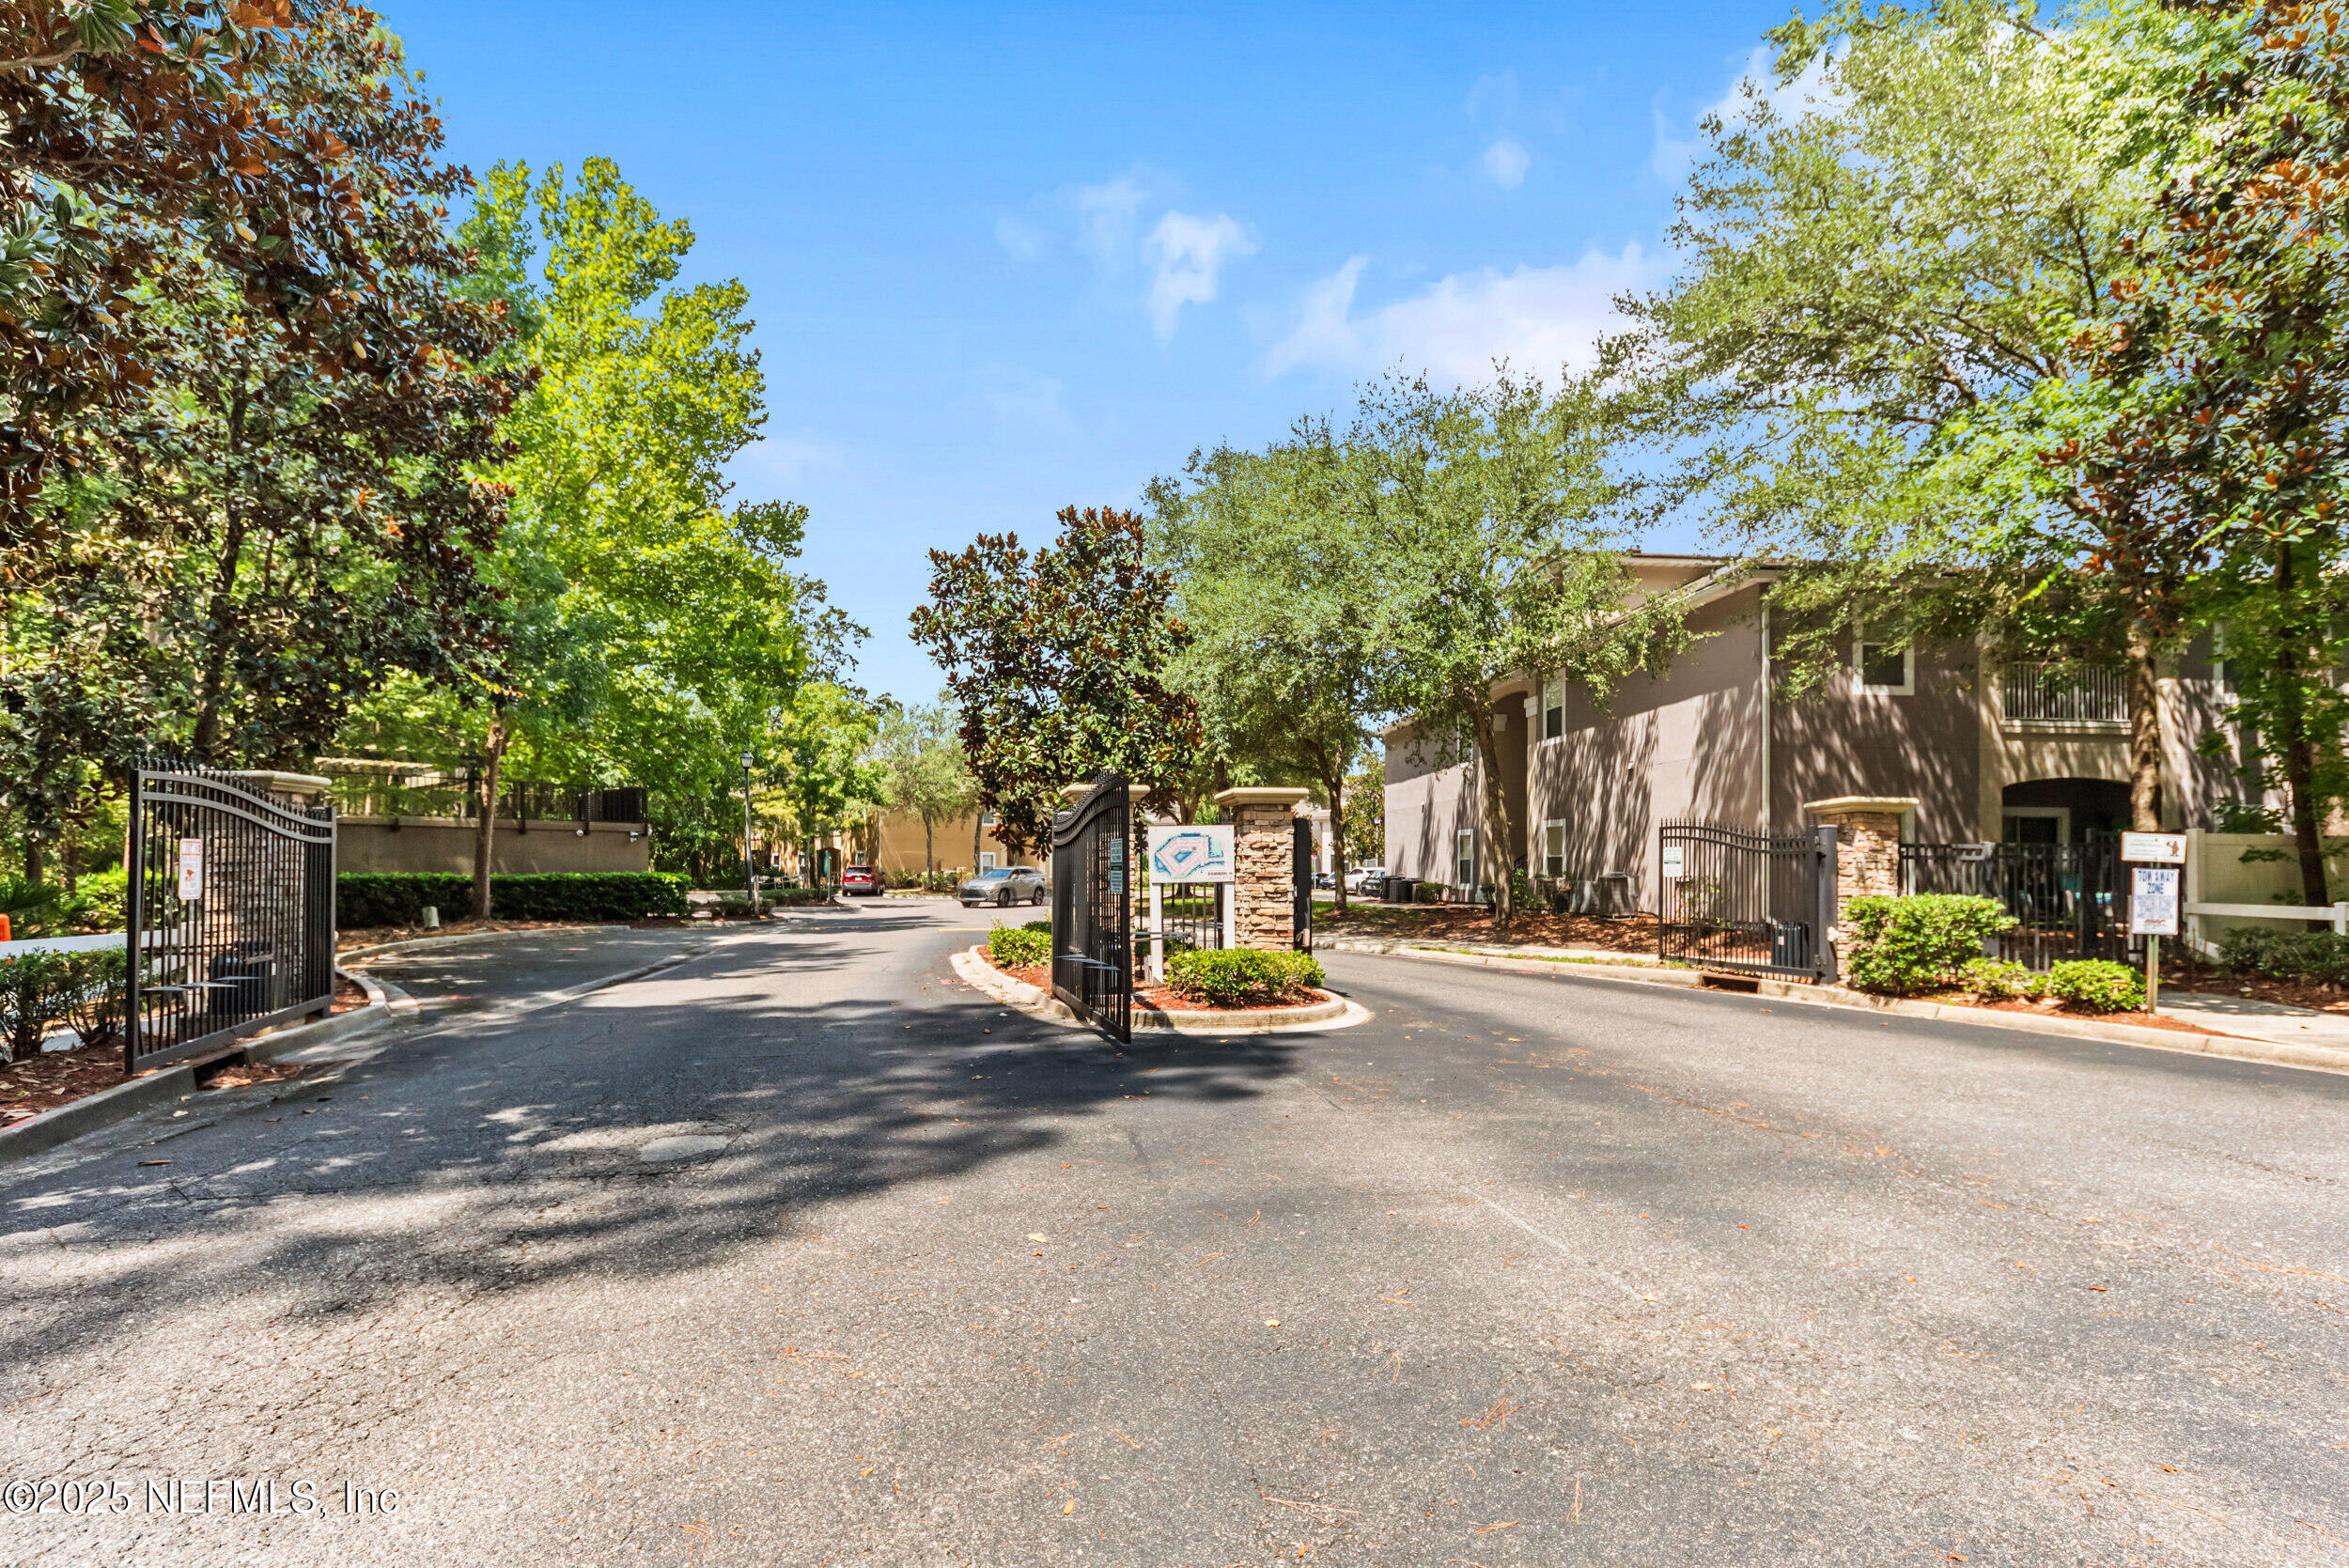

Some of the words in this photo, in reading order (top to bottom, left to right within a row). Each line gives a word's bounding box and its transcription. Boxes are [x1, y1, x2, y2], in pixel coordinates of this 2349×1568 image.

[2138, 870, 2152, 881] TOW
[2155, 871, 2174, 881] AWAY
[2147, 883, 2164, 894] ZONE
